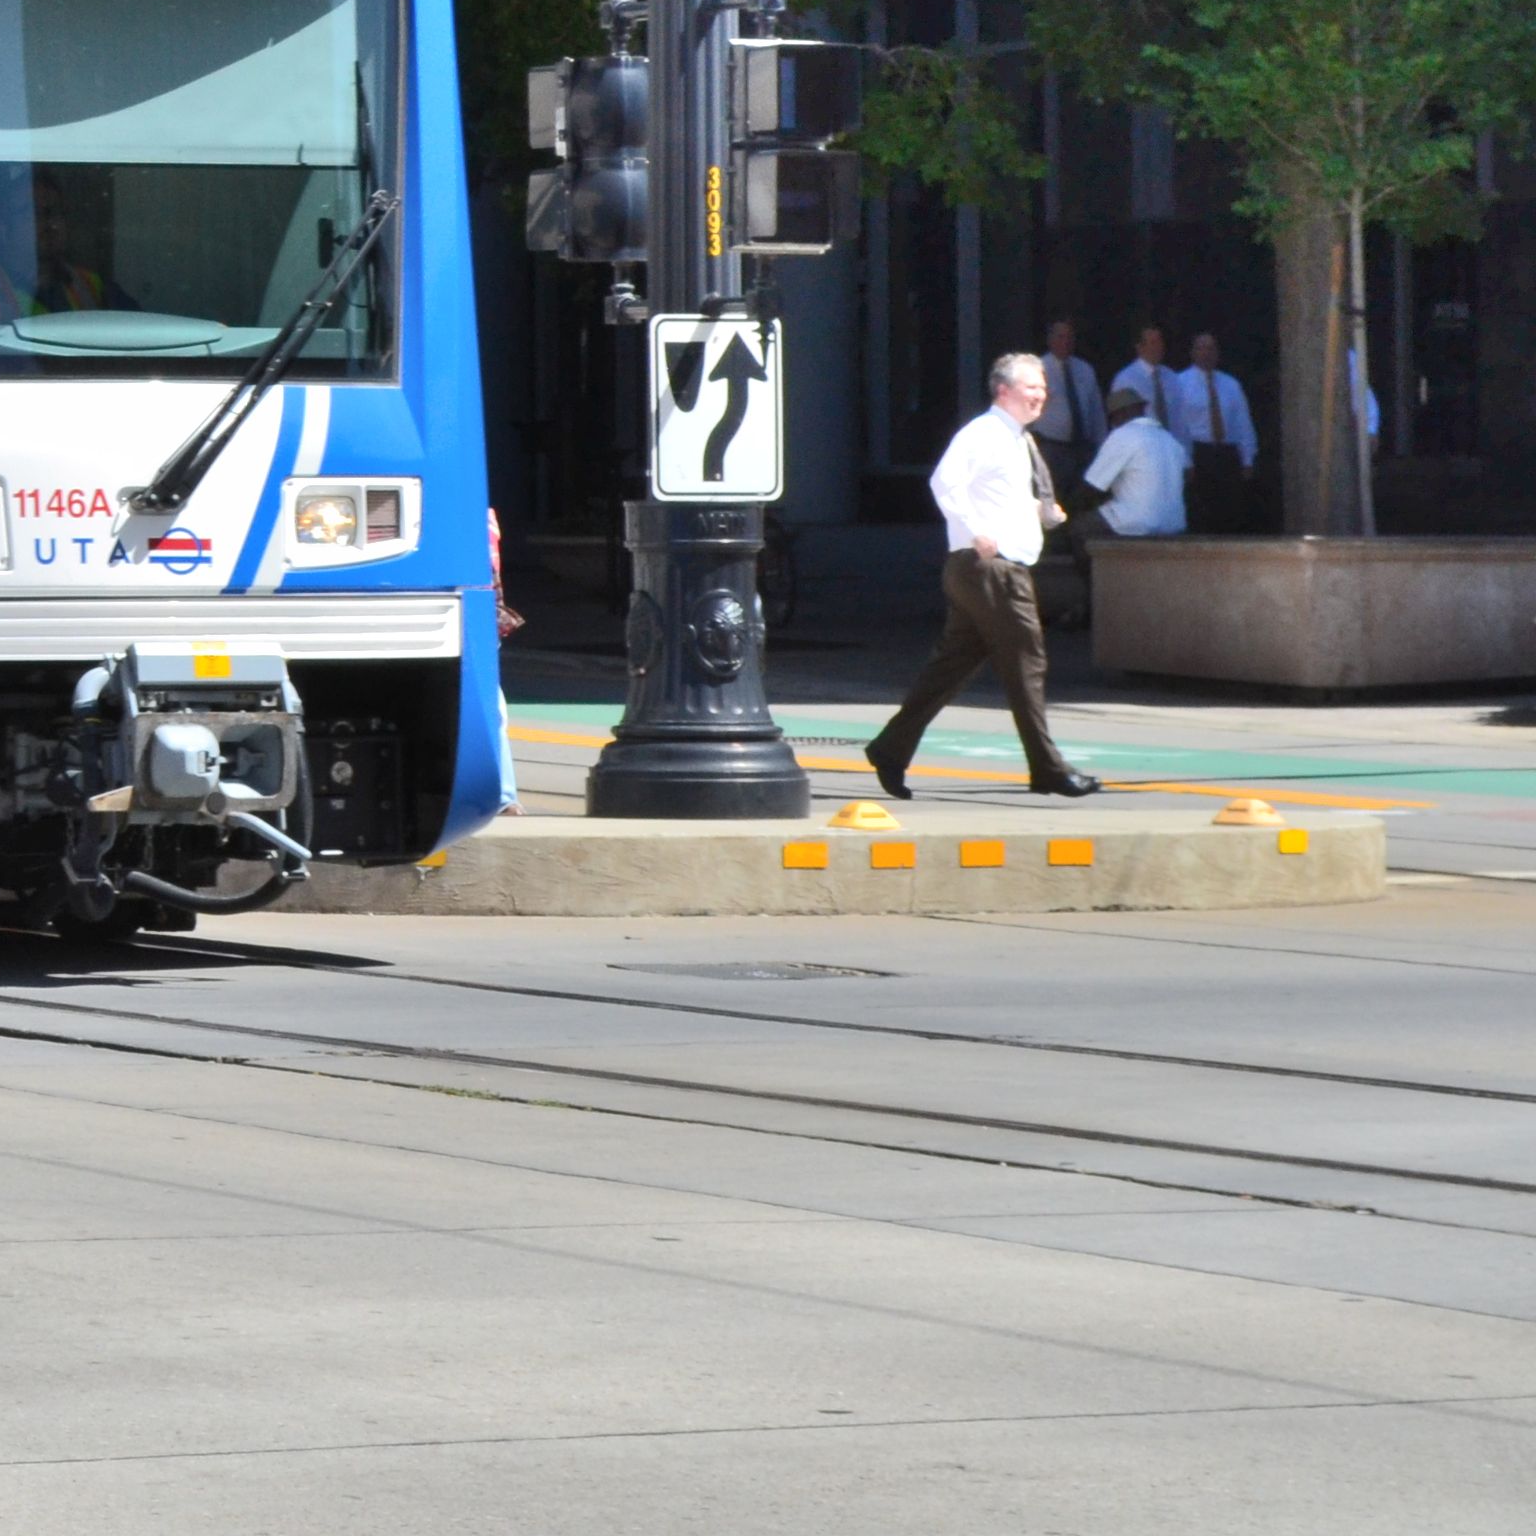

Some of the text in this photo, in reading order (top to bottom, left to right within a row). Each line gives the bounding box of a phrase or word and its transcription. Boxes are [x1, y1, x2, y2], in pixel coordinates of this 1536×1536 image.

[707, 165, 722, 256] 3093
[12, 488, 113, 519] 1146A
[34, 537, 131, 565] UTA
